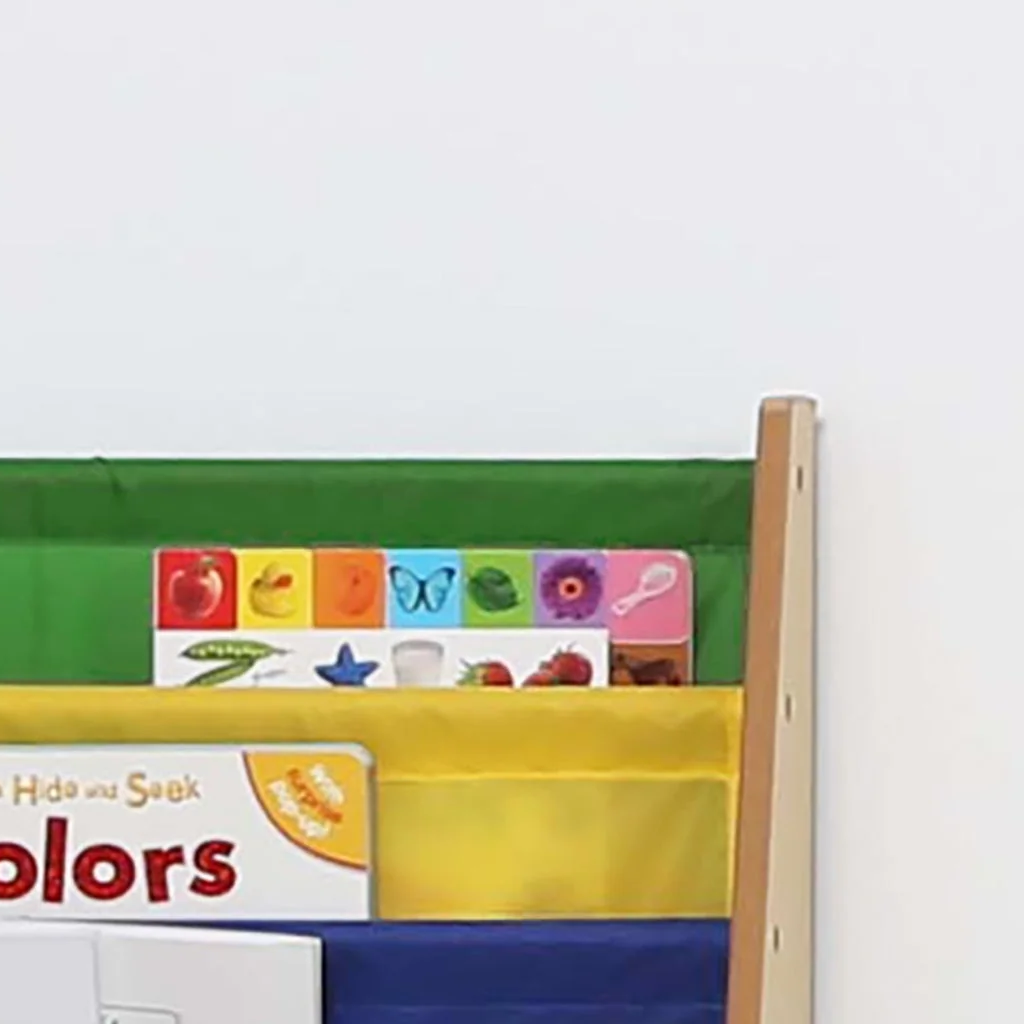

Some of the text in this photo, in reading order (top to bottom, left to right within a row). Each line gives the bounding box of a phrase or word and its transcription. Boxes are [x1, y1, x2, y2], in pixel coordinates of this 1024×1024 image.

[12, 774, 77, 805] Hide
[84, 784, 118, 801] and
[125, 771, 202, 808] Seek
